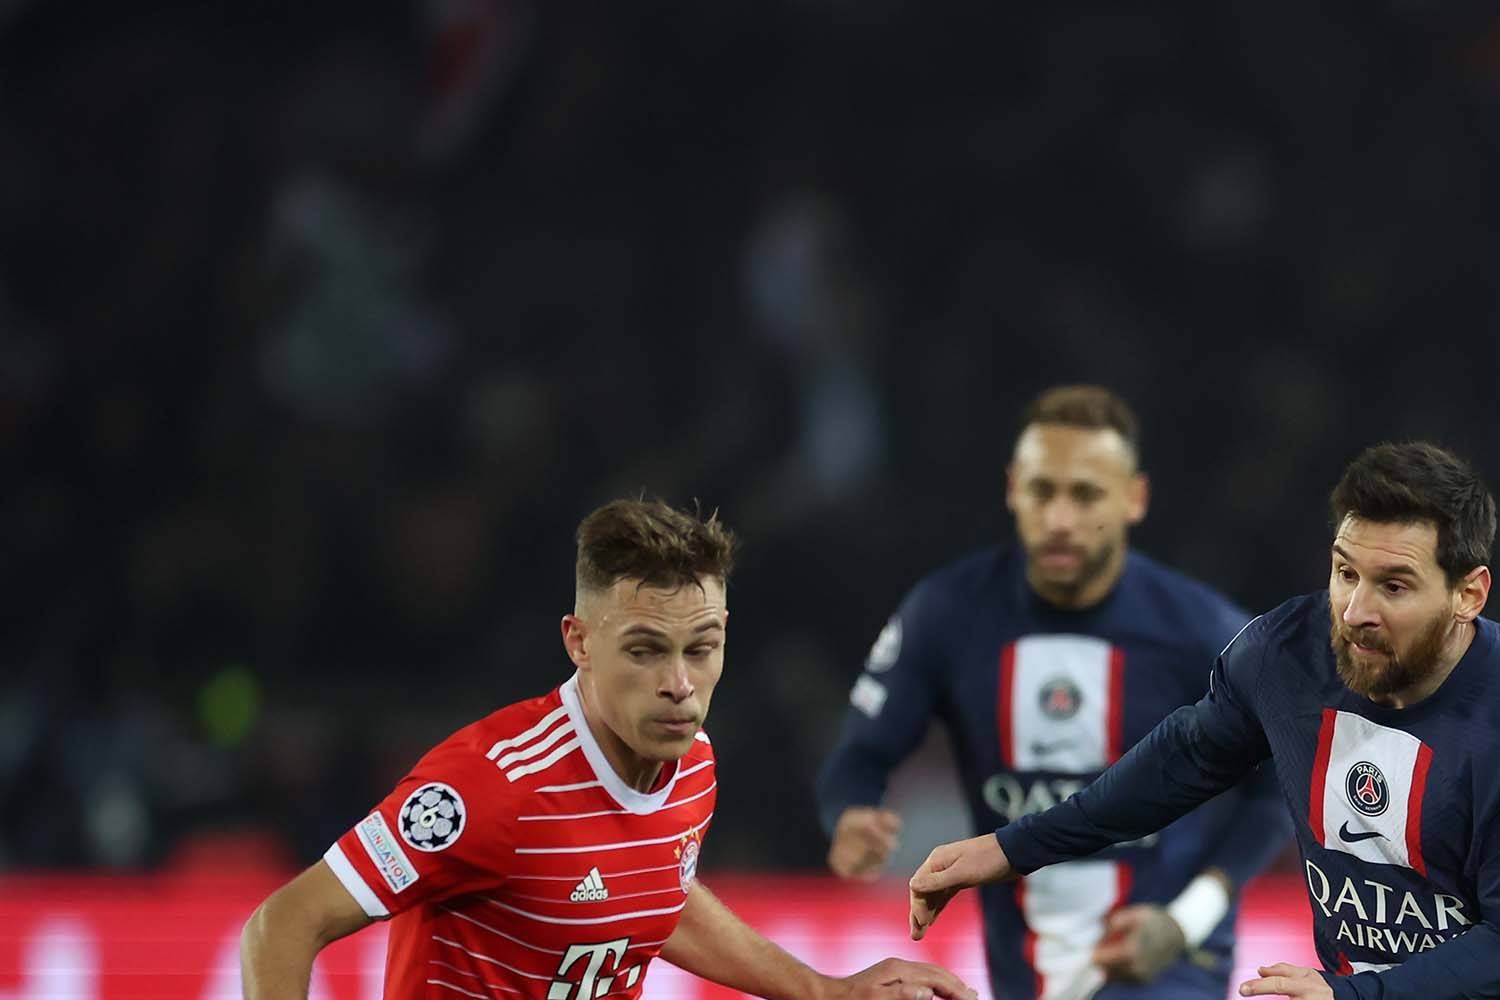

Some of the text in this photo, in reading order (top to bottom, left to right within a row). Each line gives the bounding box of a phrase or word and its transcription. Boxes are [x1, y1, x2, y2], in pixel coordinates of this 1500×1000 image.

[1356, 765, 1384, 783] PARIS
[570, 888, 609, 902] adidas
[1305, 859, 1473, 931] QATAR
[1336, 919, 1467, 954] AIRWA
